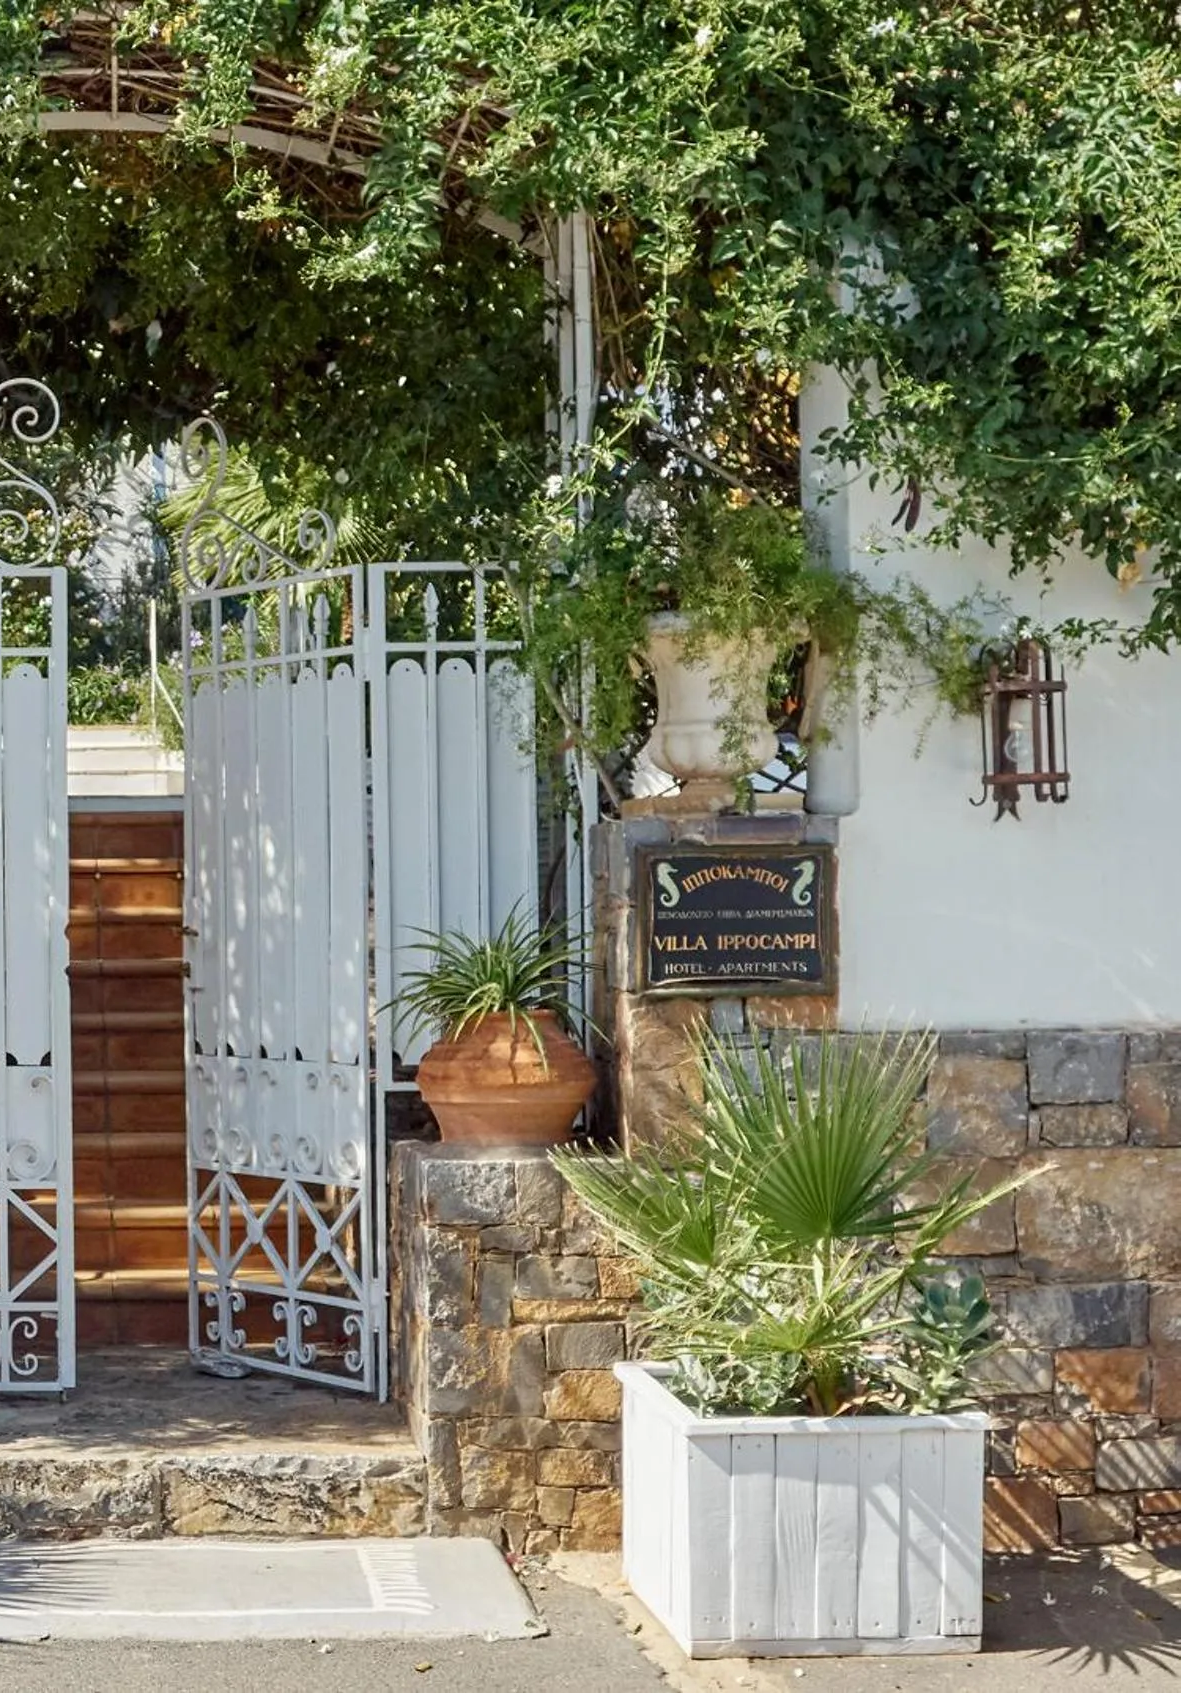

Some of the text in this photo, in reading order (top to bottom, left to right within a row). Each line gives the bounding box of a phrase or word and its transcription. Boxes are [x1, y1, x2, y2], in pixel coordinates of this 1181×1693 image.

[681, 864, 790, 893] ΙΠΠΟΚΑΜΠΟΙ
[654, 933, 816, 951] VILLA IPPOCAMPI
[718, 961, 808, 973] APARTMENTS
